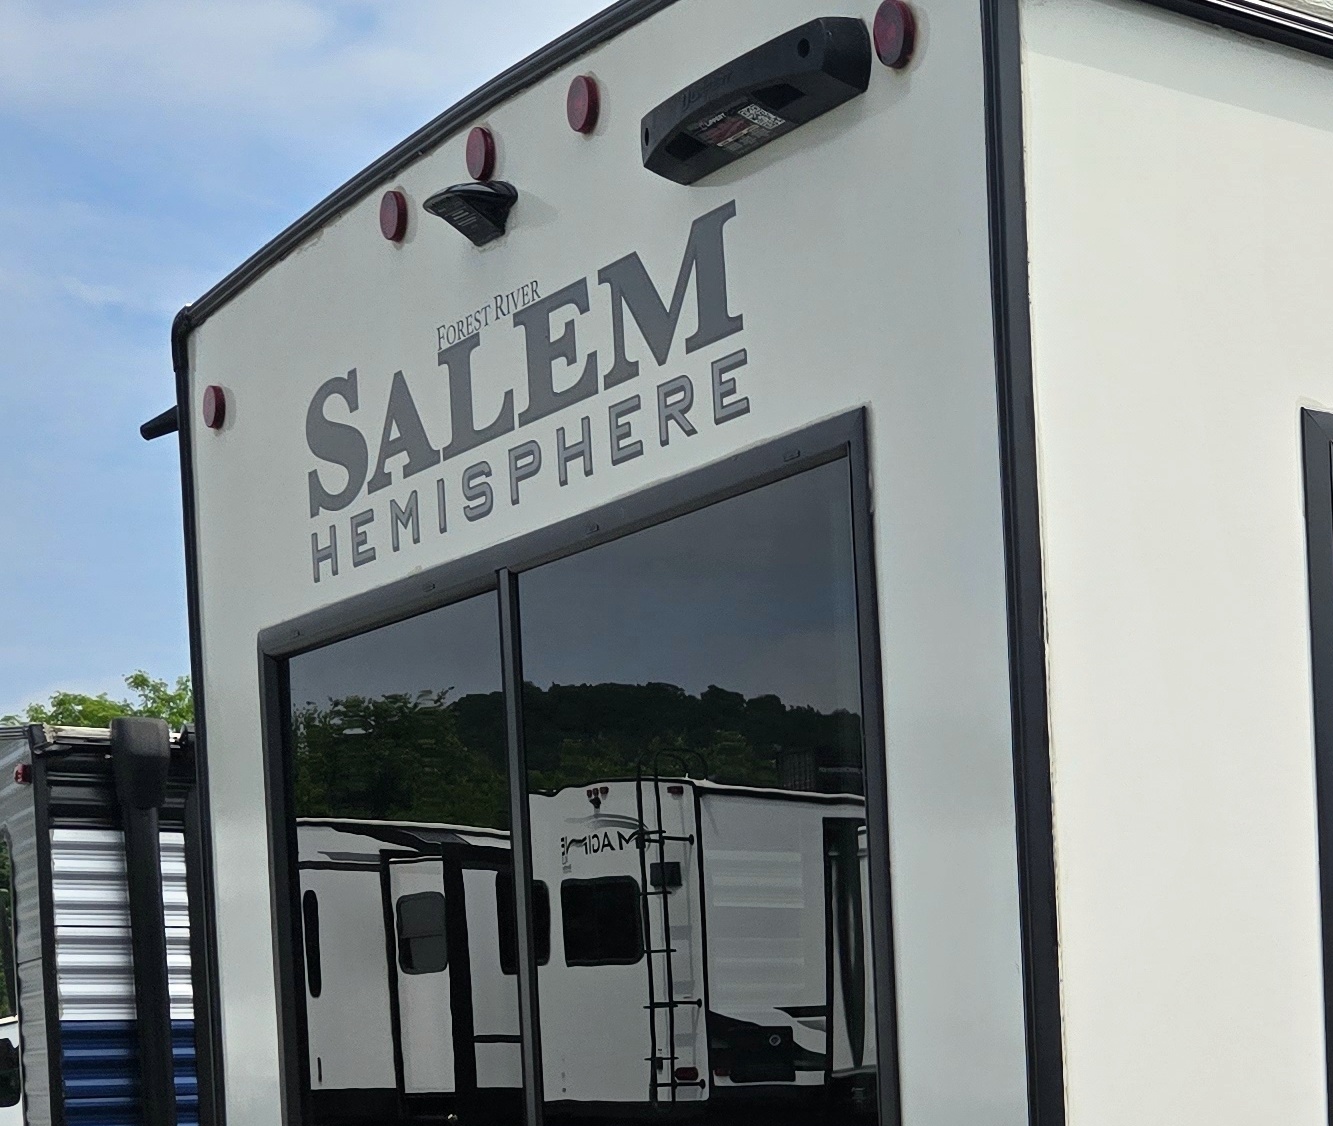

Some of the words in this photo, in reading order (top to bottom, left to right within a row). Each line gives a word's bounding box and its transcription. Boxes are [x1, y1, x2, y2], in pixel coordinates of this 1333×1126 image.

[306, 199, 743, 518] SALEM
[436, 303, 492, 351] FOREST
[493, 280, 541, 321] RIVER
[311, 348, 750, 583] HEMISPHERE
